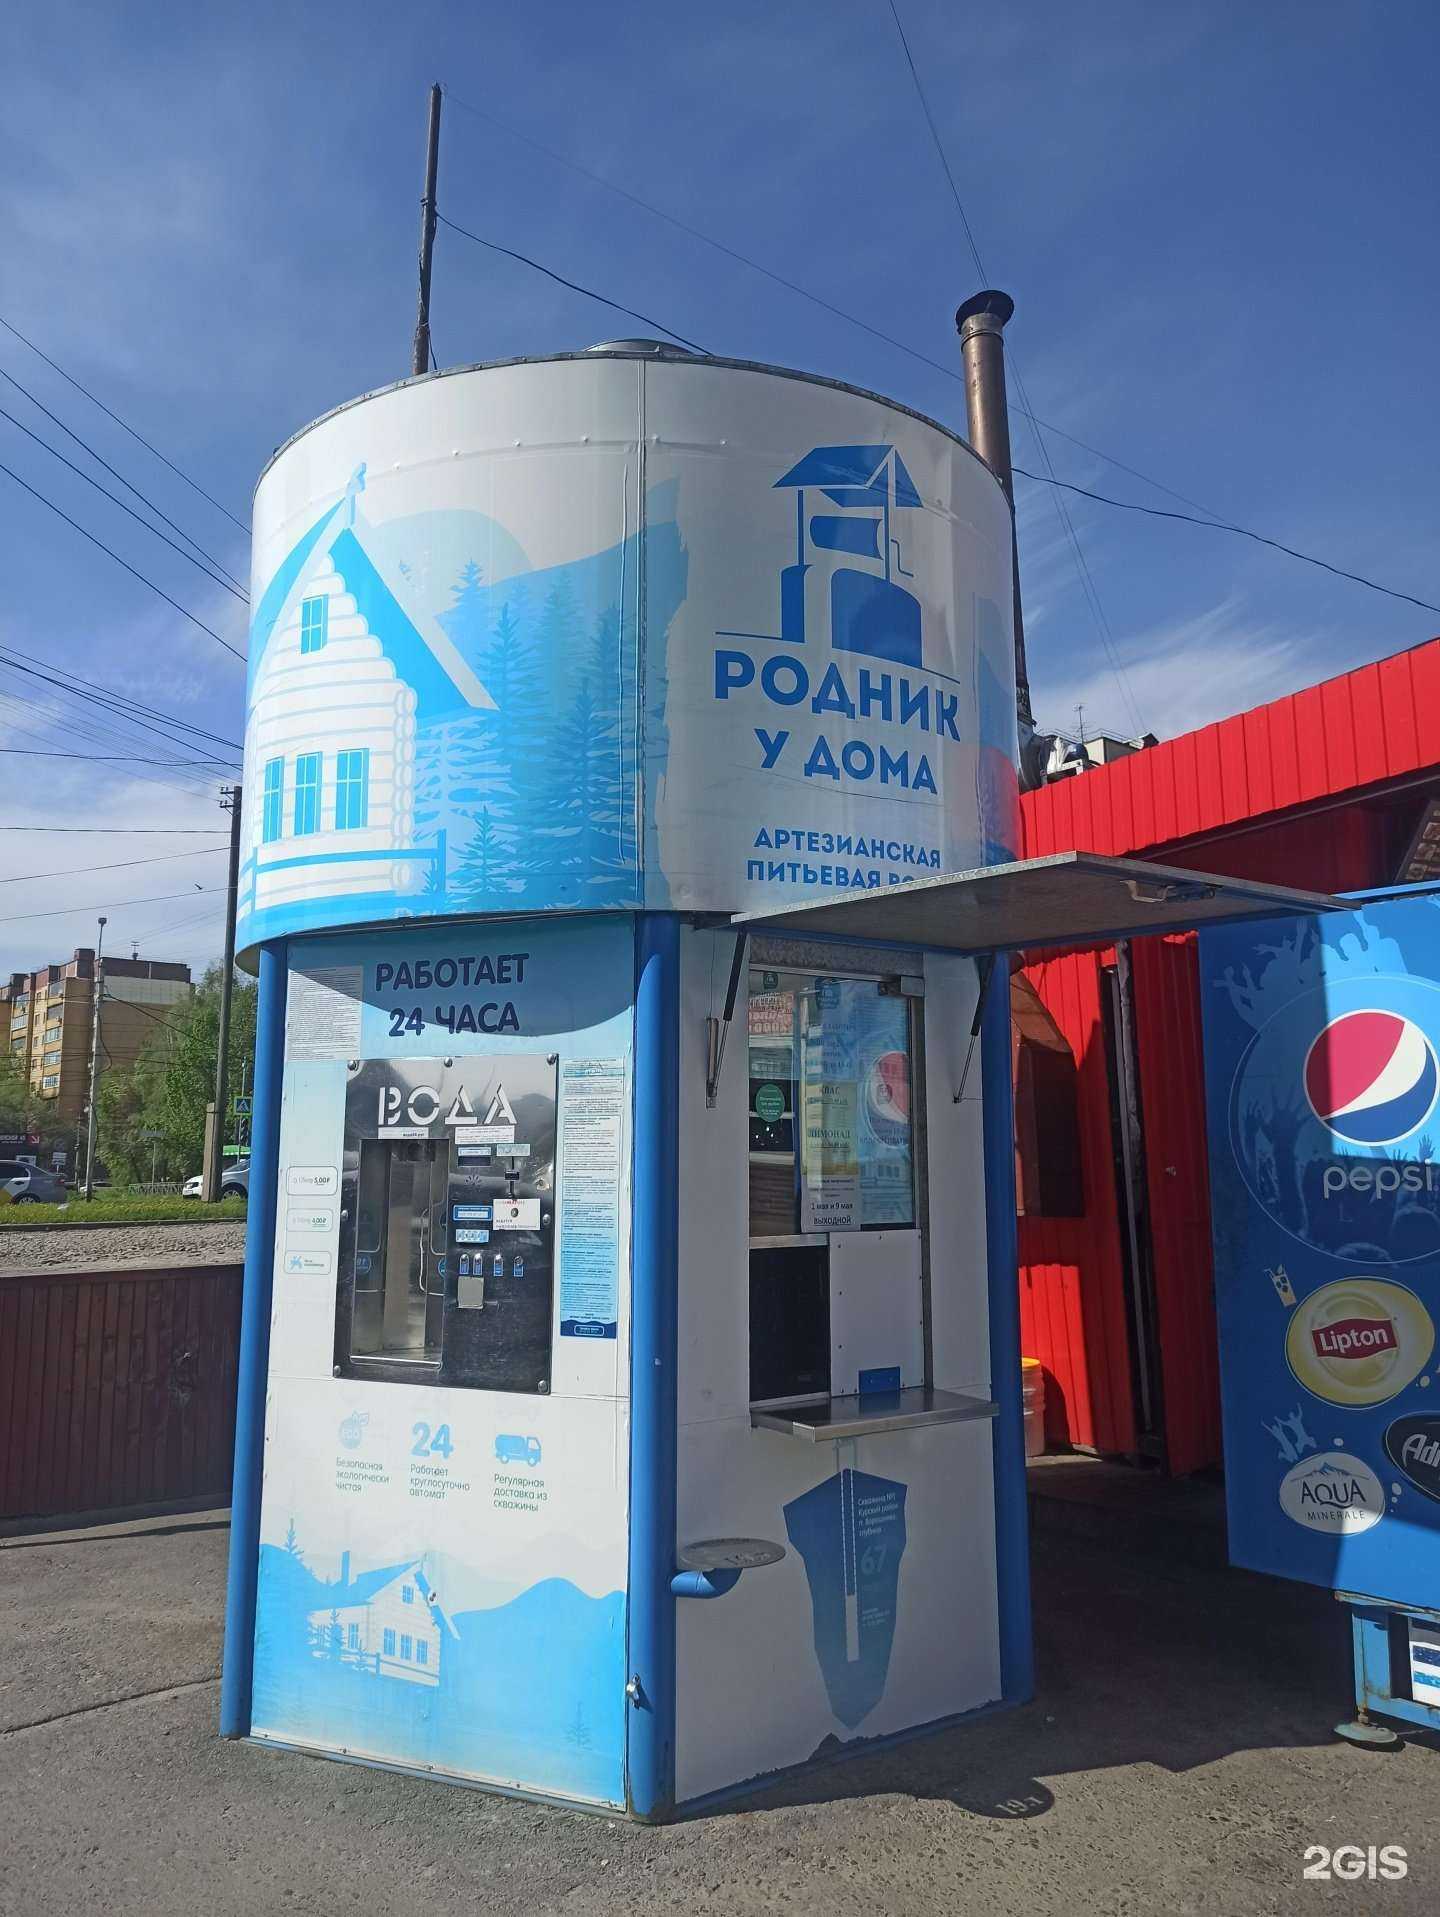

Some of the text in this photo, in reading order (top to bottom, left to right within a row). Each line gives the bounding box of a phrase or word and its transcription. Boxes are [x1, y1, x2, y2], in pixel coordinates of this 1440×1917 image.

[715, 650, 961, 742] РОДНИК
[754, 728, 938, 795] У ДОМА
[754, 827, 941, 869] АРТЕЗИАНСКАЯ
[747, 859, 881, 889] ПИТЬЕВАЯ
[376, 953, 530, 992] РАБОТАЕТ
[388, 1002, 521, 1038] 24 ЧАСА
[377, 1083, 518, 1126] ВОДА
[1323, 1158, 1432, 1199] pepsi
[1319, 1326, 1389, 1353] Lipton
[411, 1422, 454, 1459] 24
[336, 1456, 383, 1471] Безопасная
[410, 1463, 449, 1476] Работает
[335, 1482, 362, 1492] чистая
[409, 1488, 446, 1499] автомат
[410, 1478, 471, 1491] круглосуточно
[494, 1473, 545, 1488] Регулярная
[1301, 1479, 1367, 1509] AQUA
[1307, 1510, 1366, 1521] MINERALE
